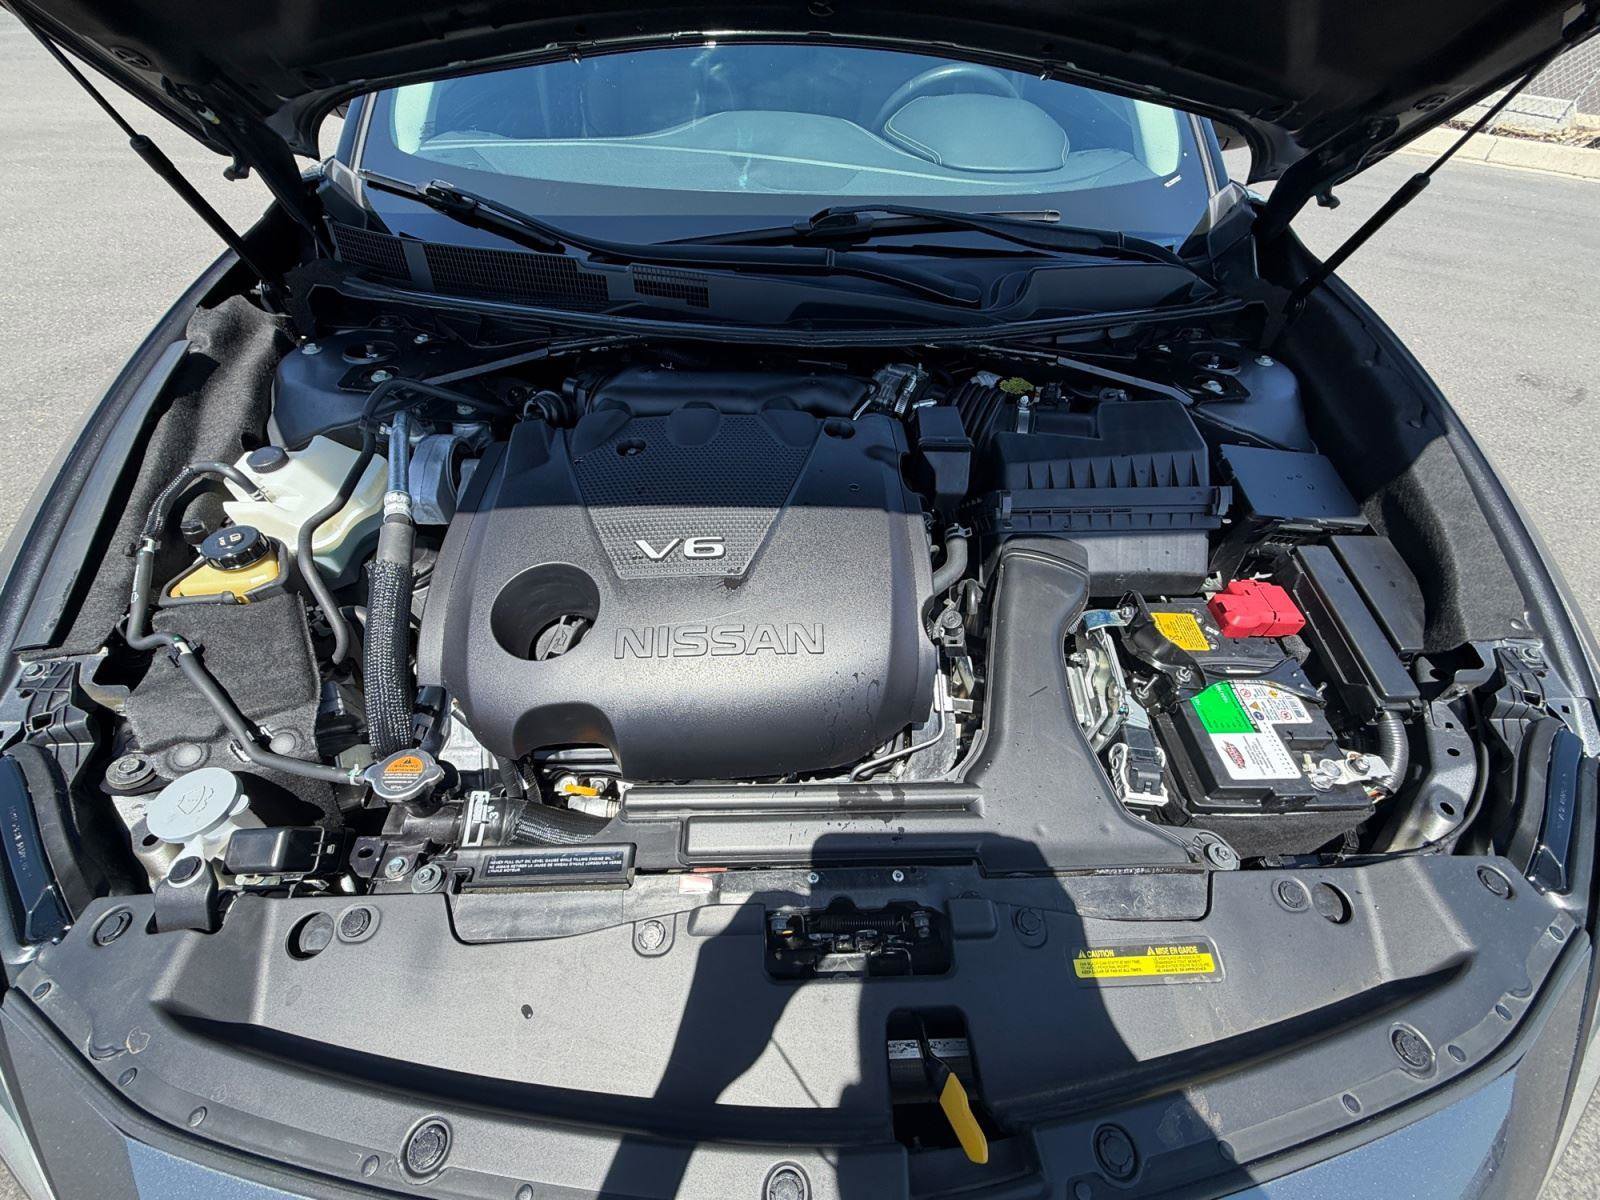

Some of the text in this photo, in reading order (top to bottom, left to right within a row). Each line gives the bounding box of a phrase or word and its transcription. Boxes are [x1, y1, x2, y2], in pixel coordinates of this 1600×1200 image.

[635, 536, 725, 560] V6
[614, 623, 825, 659] NISSAN
[1086, 949, 1115, 958] CAUTION
[1155, 946, 1198, 956] MISE EN GARDE
